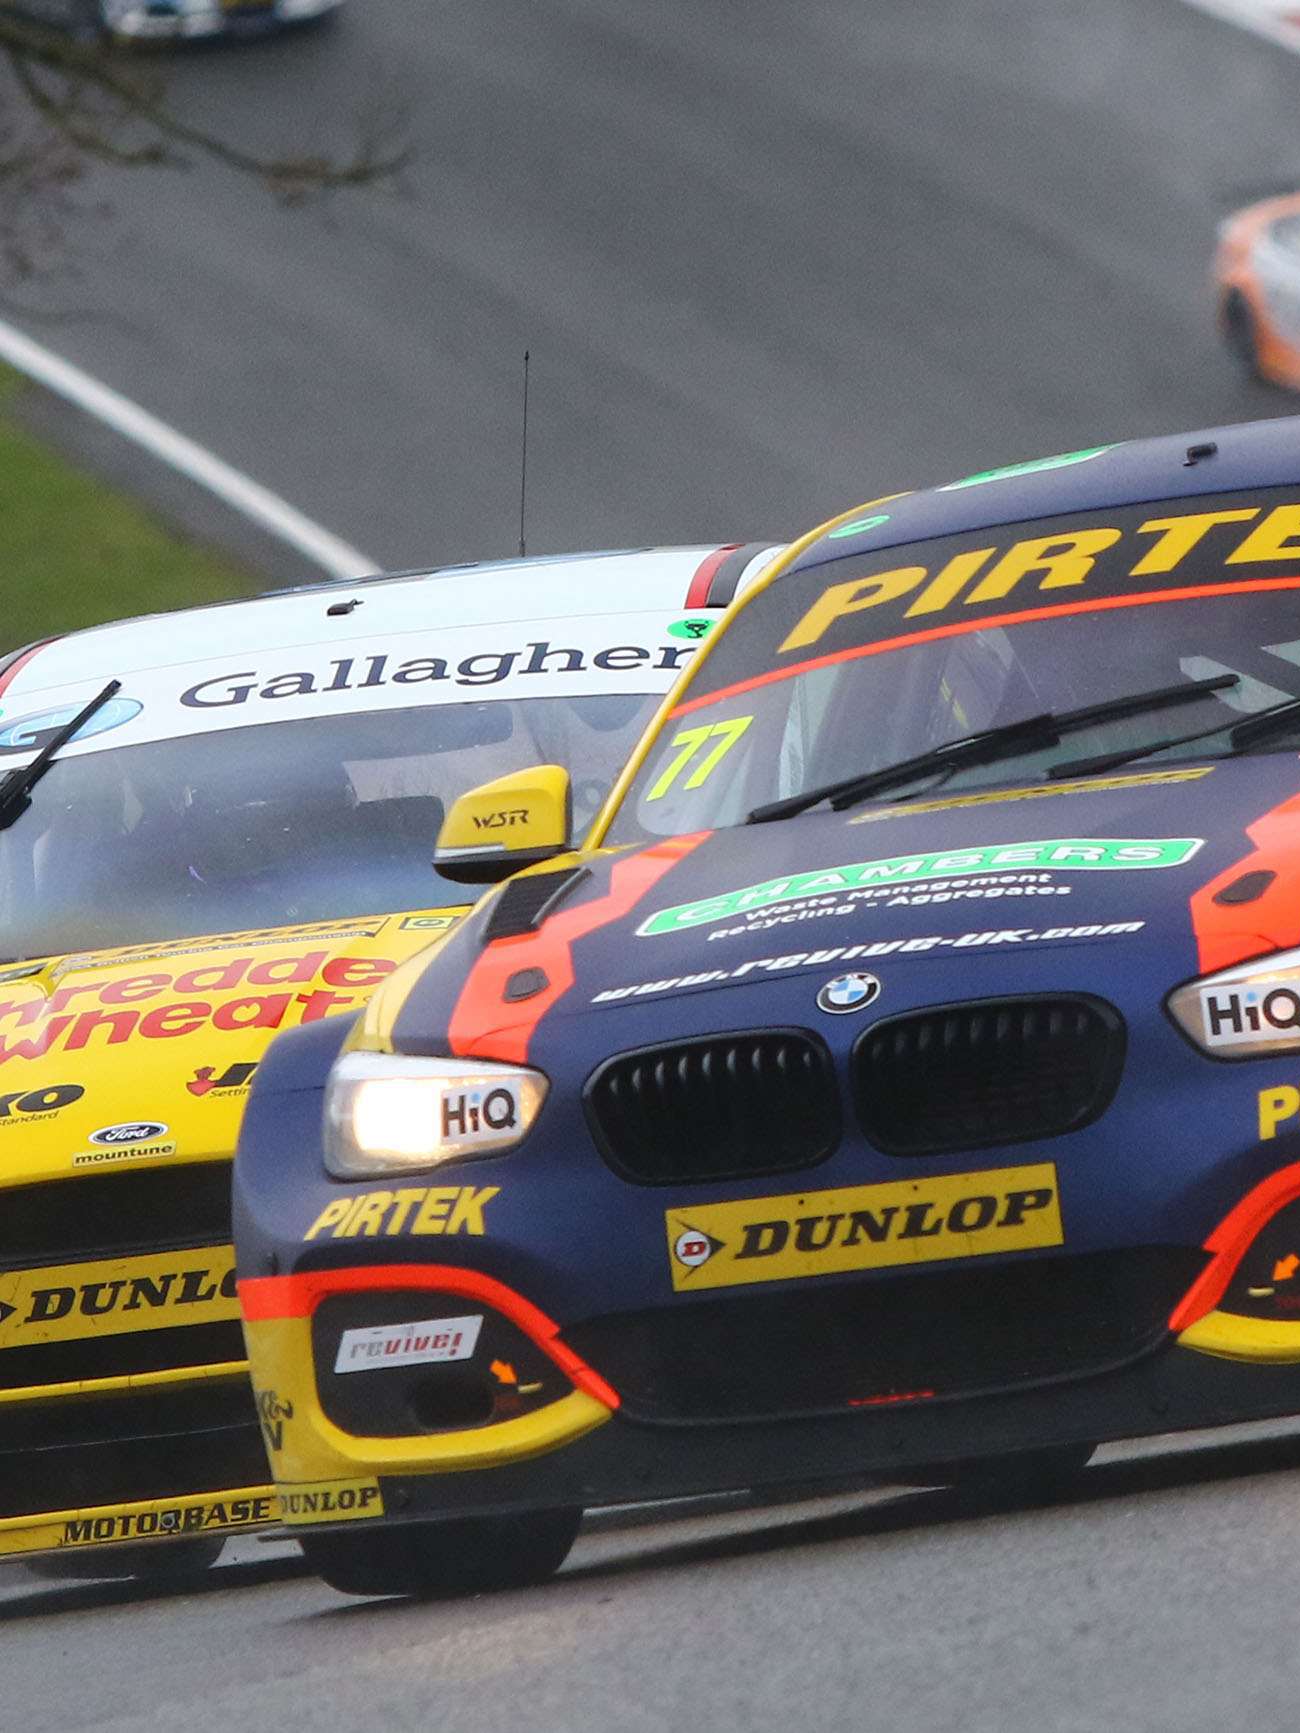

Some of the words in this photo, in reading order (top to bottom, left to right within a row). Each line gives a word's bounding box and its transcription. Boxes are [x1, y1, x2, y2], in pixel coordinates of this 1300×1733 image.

[179, 642, 697, 708] Gallagher
[645, 715, 754, 803] 77
[472, 809, 529, 831] WSR
[676, 845, 1166, 923] CHAMBERS
[745, 895, 838, 921] Waste
[846, 873, 1053, 900] Management
[706, 902, 856, 942] Recycling
[885, 884, 1072, 908] Aggregates
[105, 1126, 151, 1141] Ford
[441, 1087, 517, 1137] HiQ
[75, 1144, 173, 1164] mountune
[303, 1186, 501, 1242] PIRTEK
[733, 1188, 1053, 1261] DUNLOP
[64, 1496, 272, 1543] MOTORBASE
